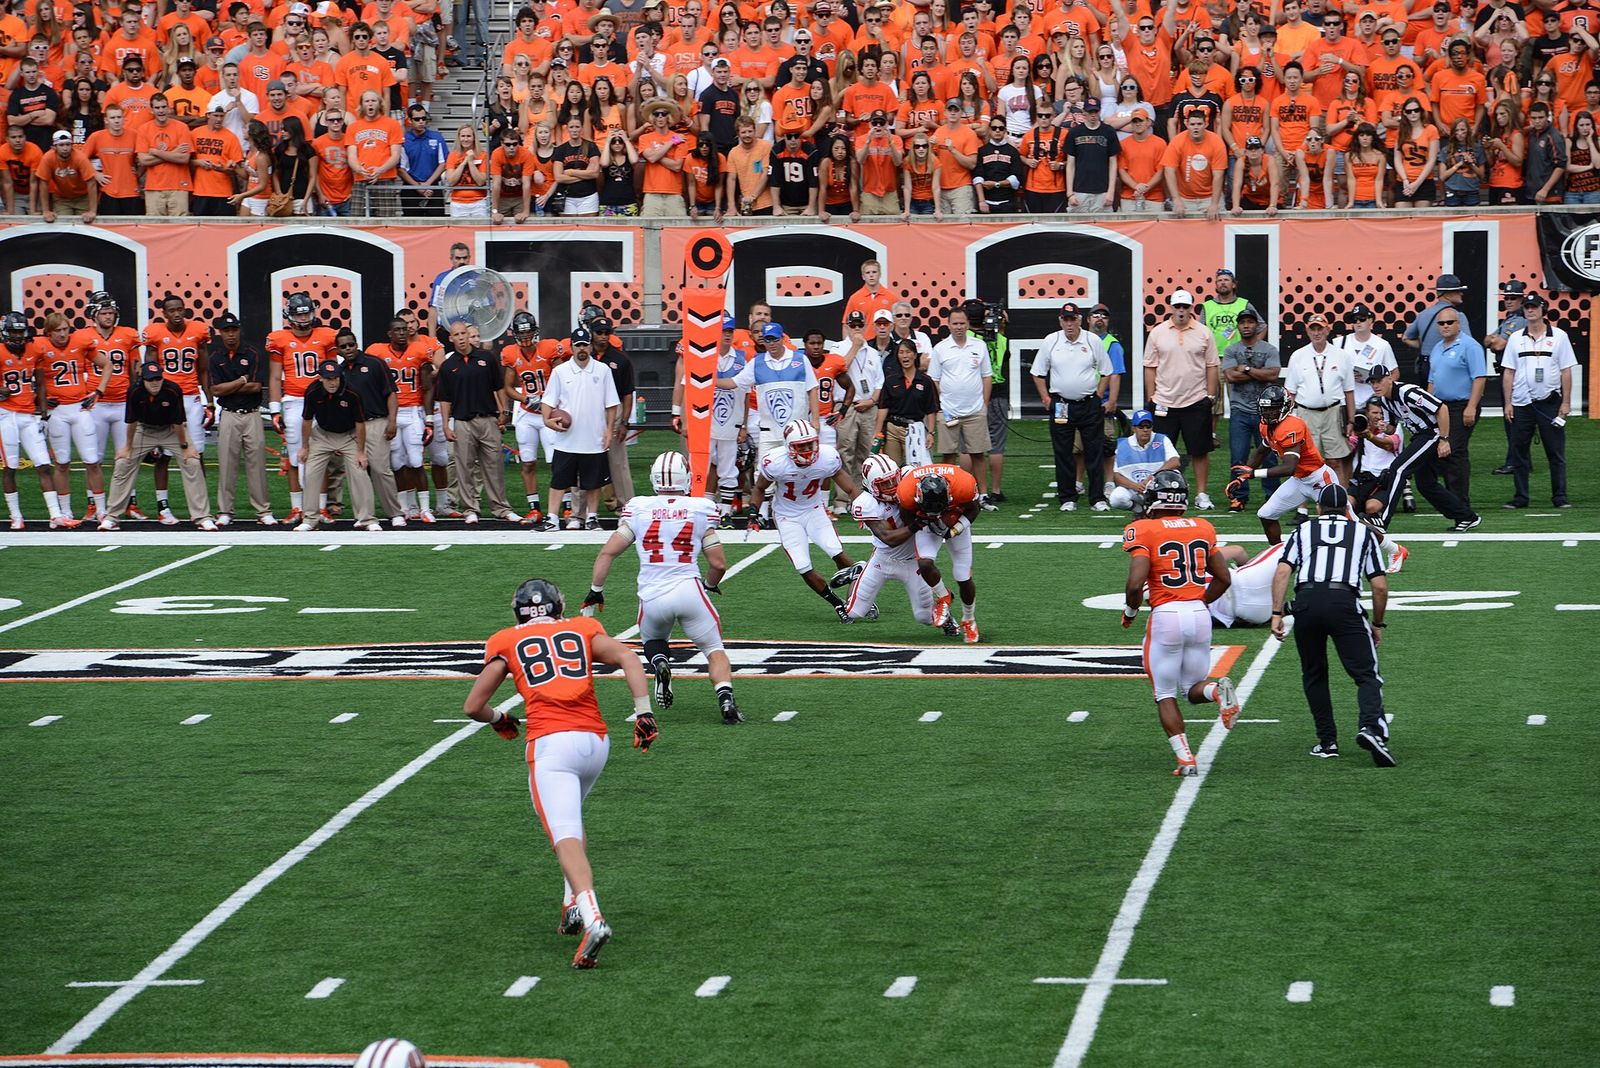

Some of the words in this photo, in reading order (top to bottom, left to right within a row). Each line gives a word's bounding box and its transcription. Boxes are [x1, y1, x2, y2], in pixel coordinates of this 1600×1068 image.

[1373, 72, 1399, 81] BEAVE
[1373, 81, 1400, 91] NATIO
[1233, 105, 1262, 114] BEAVER
[1278, 105, 1307, 114] BEAVER
[1232, 114, 1262, 123] NATION
[1278, 114, 1307, 122] NATION
[196, 137, 224, 148] BEAVER
[195, 147, 223, 156] NATION
[783, 161, 803, 183] 19
[1215, 314, 1235, 325] FOX
[162, 347, 198, 375] 86
[291, 350, 319, 379] 10
[51, 359, 79, 387] 21
[3, 367, 36, 396] 84
[519, 369, 546, 399] 81
[717, 407, 729, 419] 12
[775, 408, 788, 420] 12
[1286, 431, 1297, 444] 7
[911, 465, 955, 478] WHEATON
[782, 477, 822, 502] 14
[1166, 492, 1182, 503] 30
[651, 508, 688, 520] BORLAND
[1163, 517, 1197, 529] AGNEW
[1318, 519, 1348, 545] U
[642, 519, 695, 564] 44
[1159, 538, 1210, 589] 30
[529, 604, 547, 618] 89
[515, 630, 588, 688] 89
